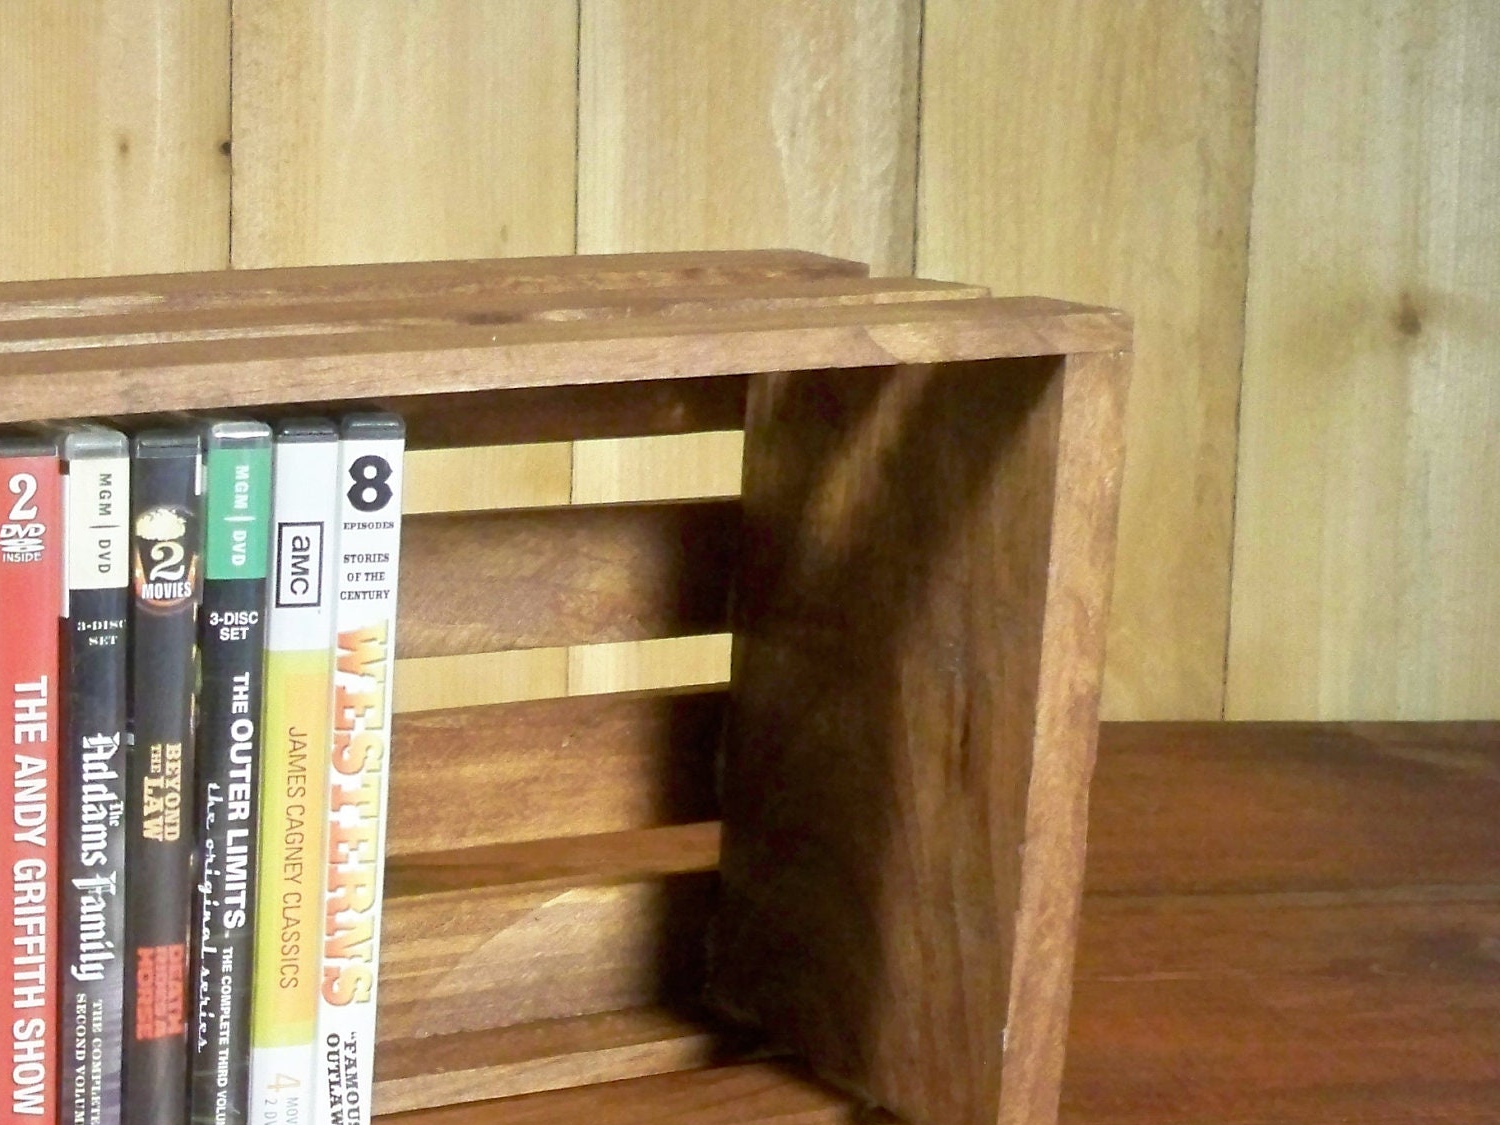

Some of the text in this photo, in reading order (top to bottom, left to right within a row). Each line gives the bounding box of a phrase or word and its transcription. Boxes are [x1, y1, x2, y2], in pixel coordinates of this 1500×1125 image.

[8, 473, 38, 521] 2
[346, 454, 394, 513] 8
[0, 524, 46, 539] DVD
[97, 473, 113, 574] MGM DVD
[231, 464, 250, 567] MGM DVD
[343, 520, 395, 531] EPISODES
[3, 551, 42, 563] INSIDE
[150, 540, 186, 581] 2
[343, 552, 391, 564] STORIES
[347, 570, 386, 583] OF THE
[141, 581, 192, 600] MOVIES
[339, 589, 391, 601] CENTURY
[209, 611, 259, 627] 3-DISC
[219, 628, 250, 641] SET
[108, 800, 125, 827] The
[142, 744, 163, 842] THE LAW
[164, 742, 182, 841] BEYOND
[222, 672, 255, 930] THE OUTER LIMITS
[320, 619, 390, 1008] WESTERNS
[71, 731, 122, 982] Addams Family
[279, 725, 309, 990] JAMES CAGNEY CLASSICS
[12, 674, 48, 1116] THE ANDY GRIFFITH SHOW
[197, 782, 224, 1053] the original series
[221, 946, 234, 972] THE
[75, 992, 88, 1060] SECOND
[219, 975, 232, 1045] COMPLETE
[90, 998, 104, 1125] THE COMPLETE
[217, 1048, 230, 1088] THIRD
[266, 1072, 302, 1093] 4
